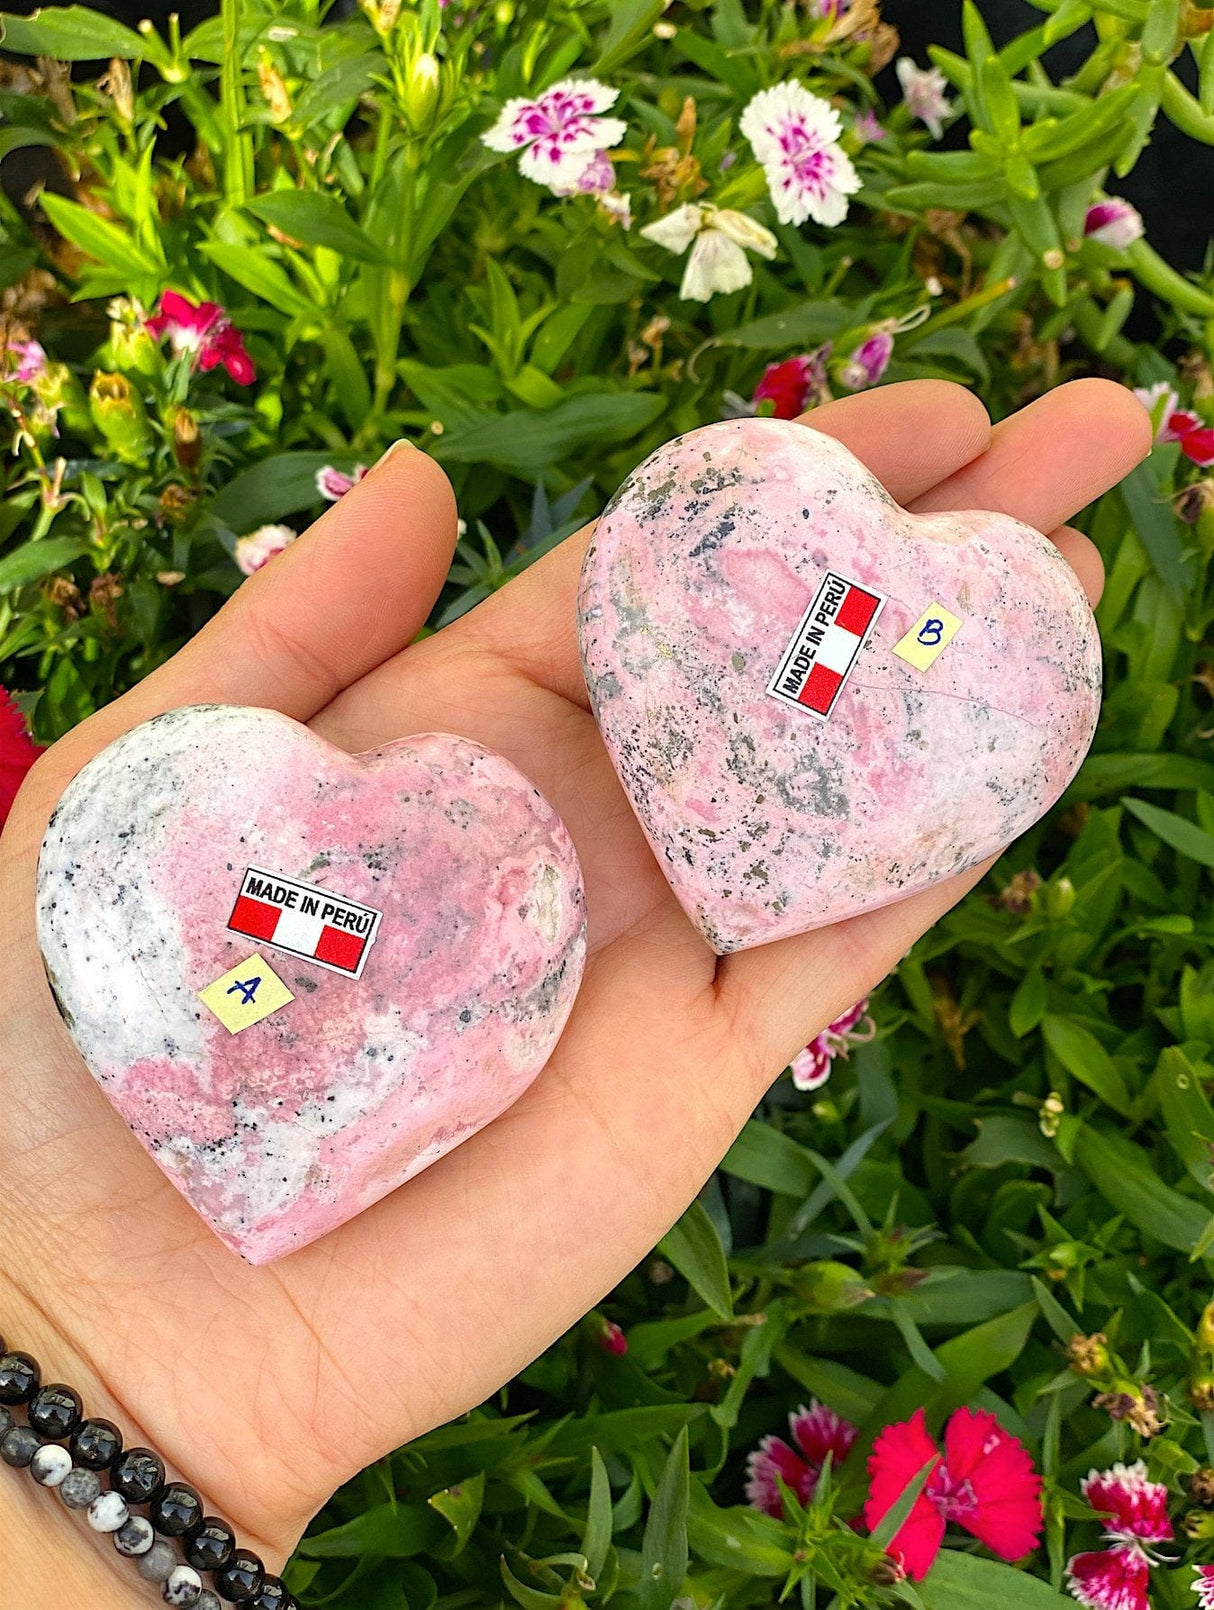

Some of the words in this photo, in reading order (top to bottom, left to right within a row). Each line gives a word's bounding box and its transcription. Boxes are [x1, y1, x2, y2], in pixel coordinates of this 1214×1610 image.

[814, 579, 846, 627] PERÚ
[805, 625, 826, 646] IN
[917, 618, 944, 646] B
[782, 645, 817, 694] MADE
[245, 877, 300, 909] MADE
[299, 895, 320, 917] IN
[320, 903, 370, 934] PERÚ
[226, 976, 262, 1005] A
